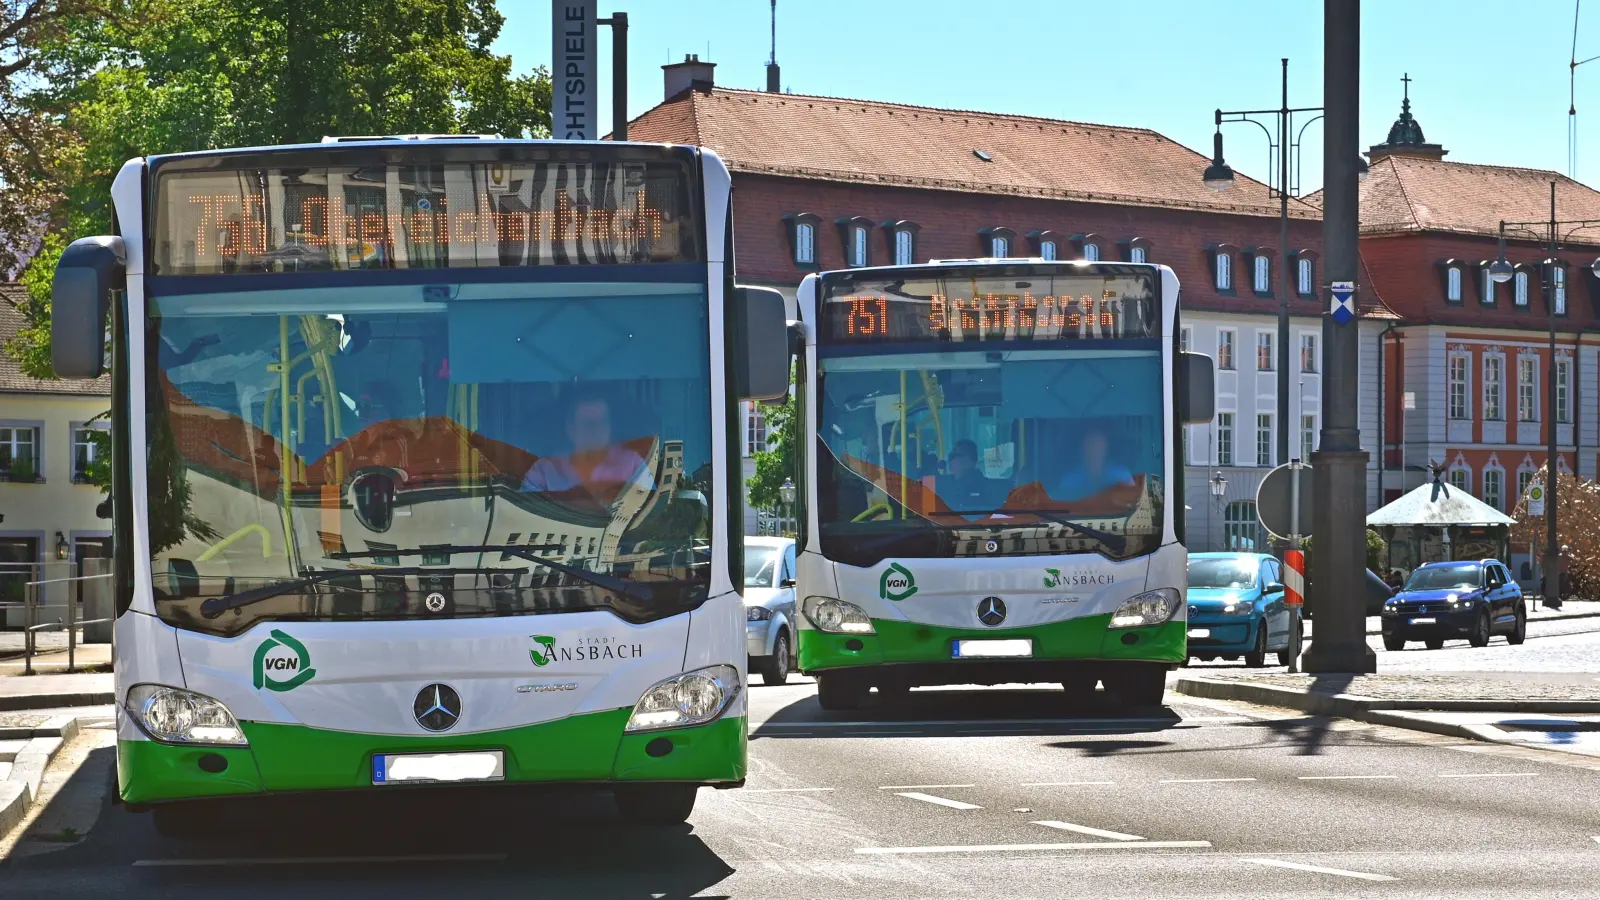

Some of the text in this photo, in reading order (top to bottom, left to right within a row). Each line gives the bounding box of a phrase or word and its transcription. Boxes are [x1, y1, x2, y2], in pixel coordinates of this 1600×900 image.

[188, 189, 662, 256] 756 Obereichenbach
[843, 295, 886, 334] 751
[929, 310, 1114, 330] Schalkhausen
[1052, 574, 1114, 586] ANSBACH
[578, 637, 616, 645] STADT
[542, 643, 642, 662] ANSBACH
[265, 657, 298, 670] VGN
